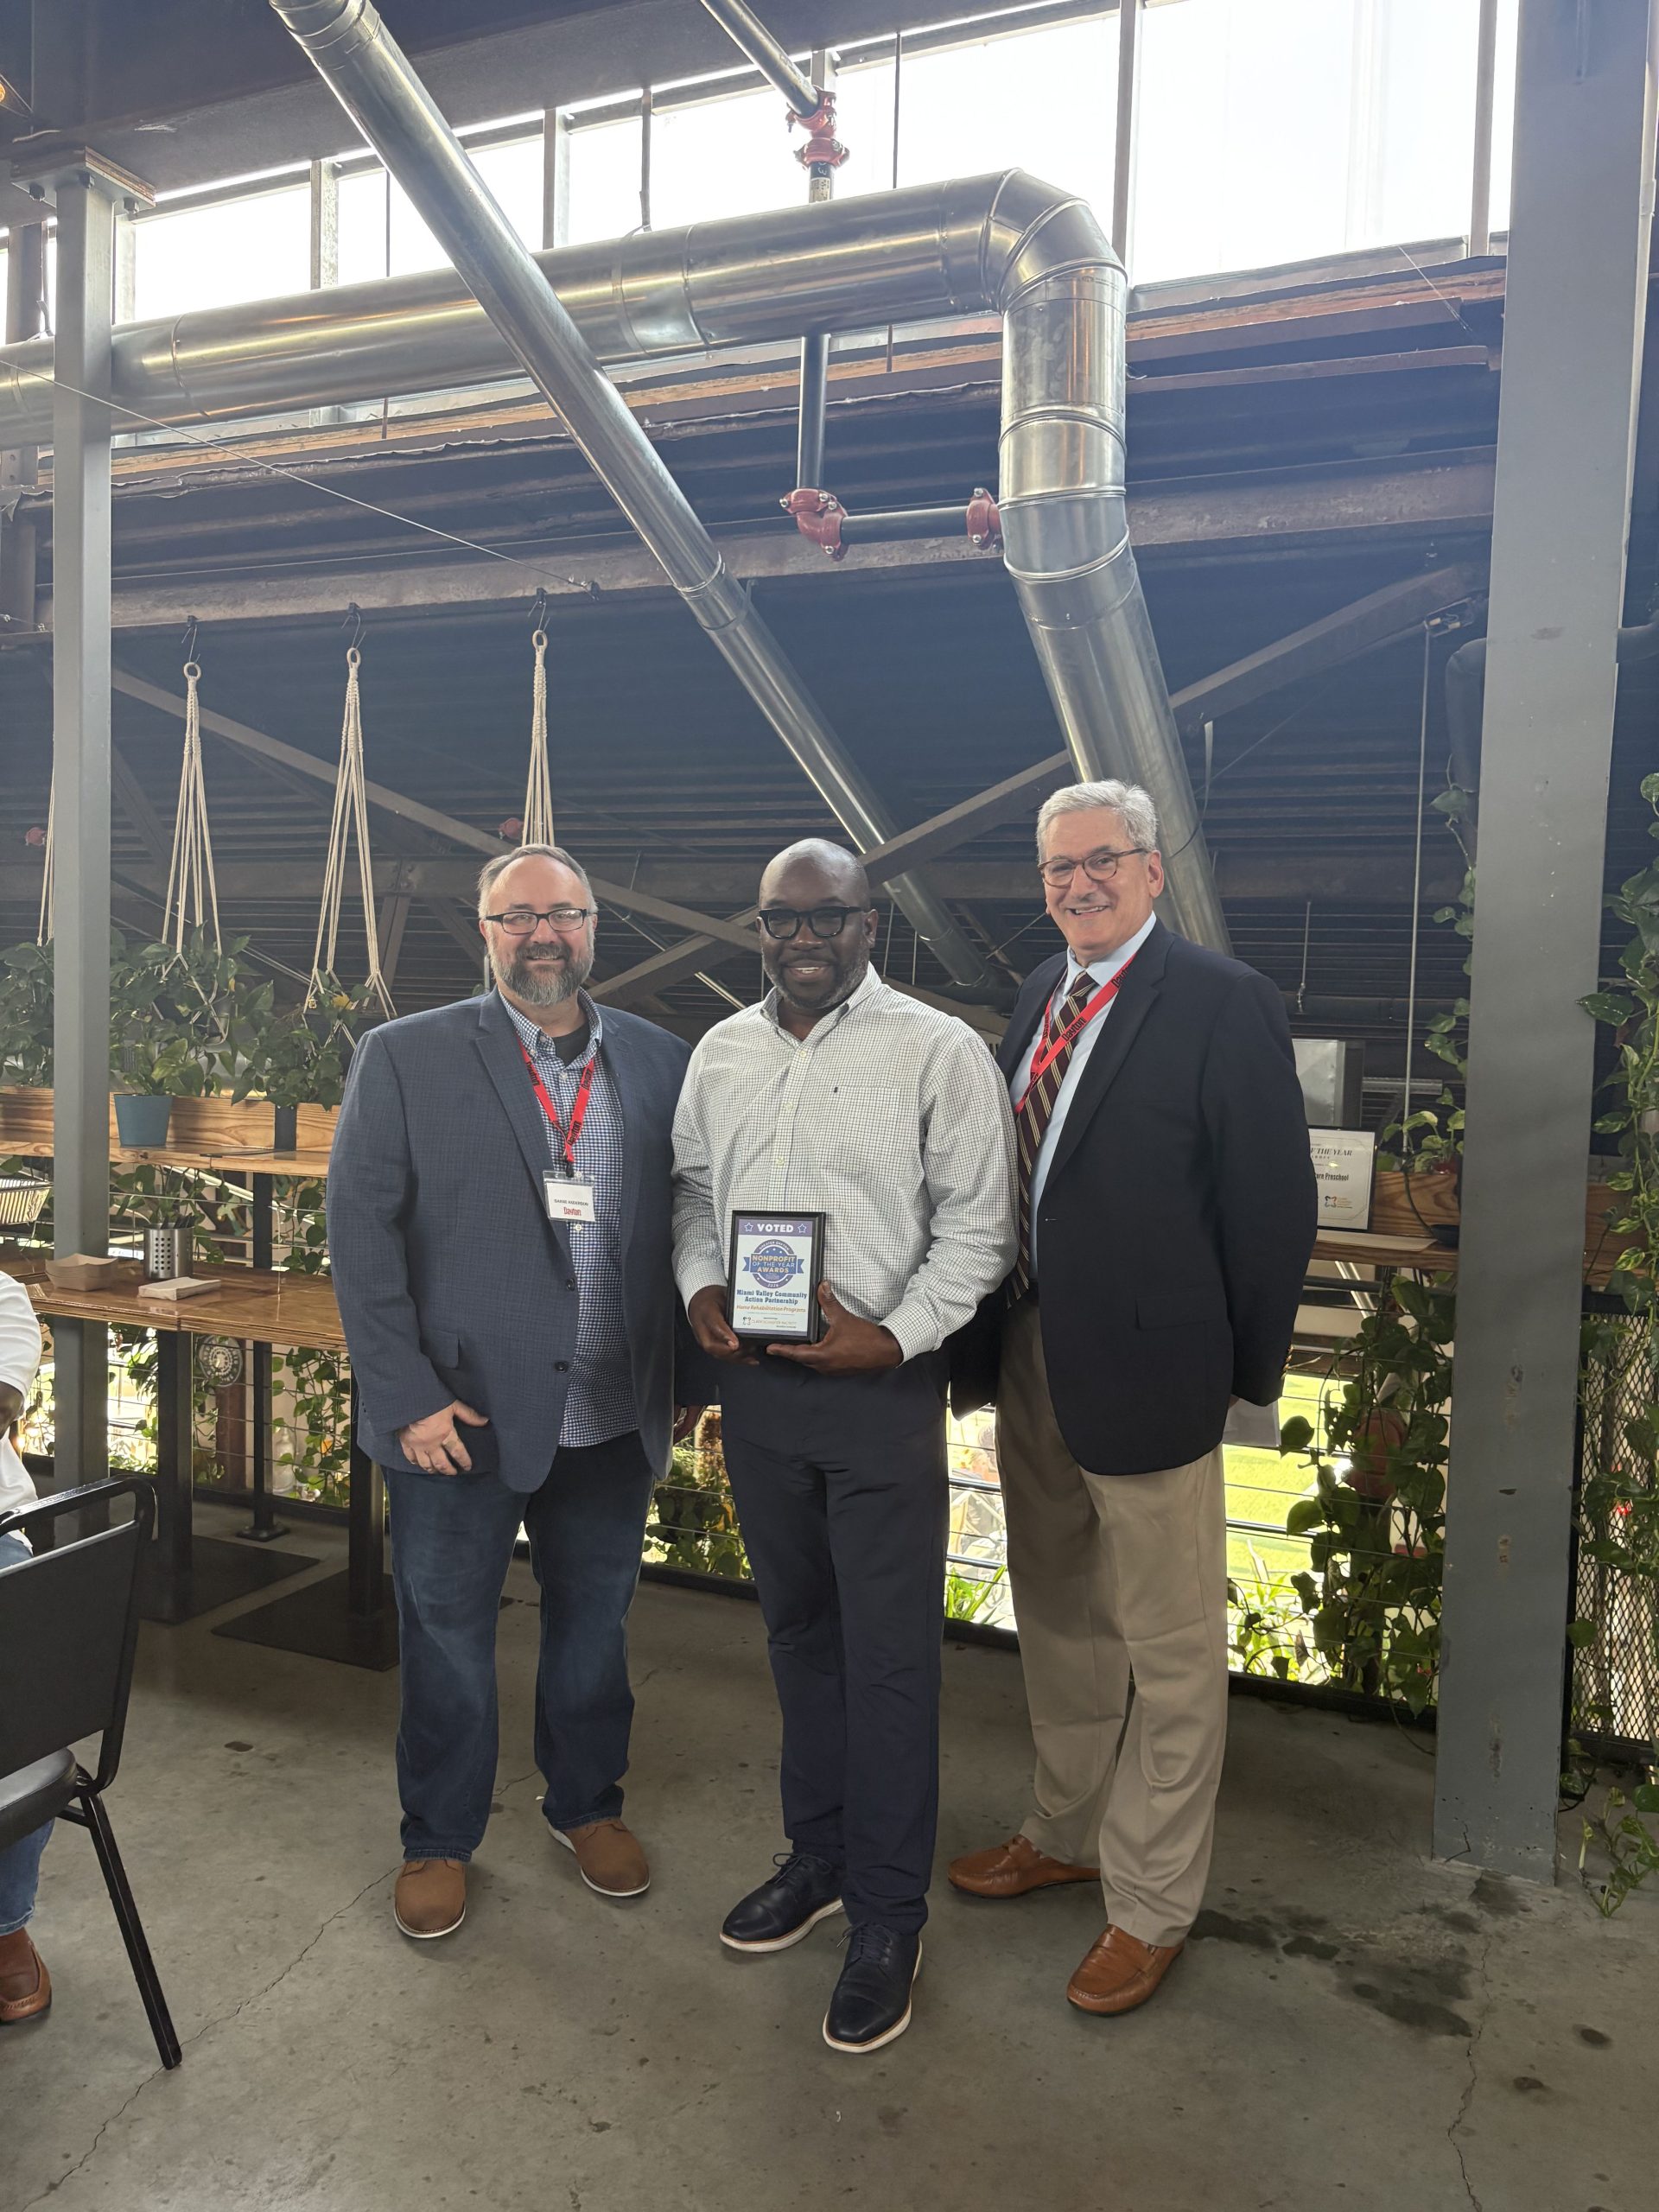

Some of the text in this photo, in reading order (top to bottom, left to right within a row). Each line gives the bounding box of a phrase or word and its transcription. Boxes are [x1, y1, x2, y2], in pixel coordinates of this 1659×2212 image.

[1061, 1016, 1087, 1042] Dayton
[563, 1206, 582, 1217] Dayton
[757, 1224, 794, 1233] VOTED
[774, 1290, 808, 1300] Community
[764, 1297, 798, 1306] Partnership
